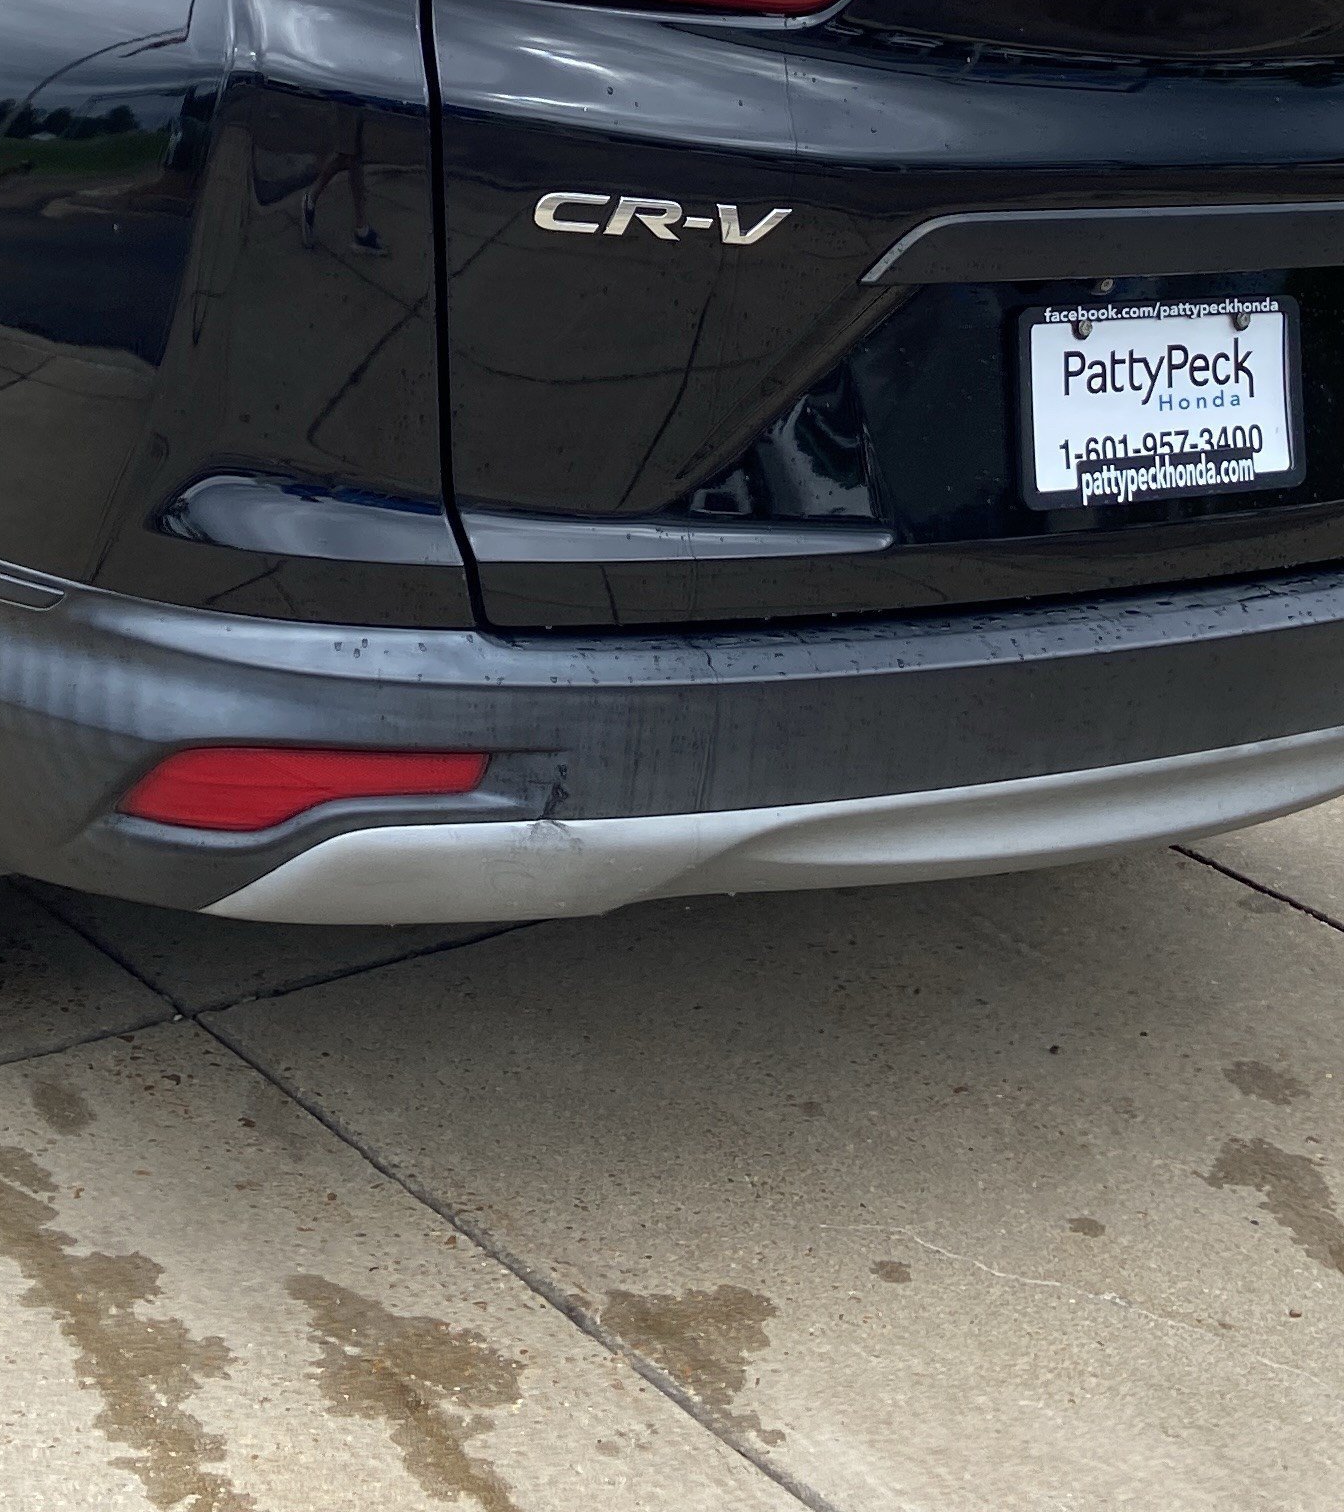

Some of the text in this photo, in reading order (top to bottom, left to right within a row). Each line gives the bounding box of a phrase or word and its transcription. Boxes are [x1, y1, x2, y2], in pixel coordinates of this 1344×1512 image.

[533, 191, 793, 245] CR-V
[1044, 297, 1279, 322] facebook.com/pattypeckhonda
[1062, 337, 1256, 406] PattyPeck
[1158, 390, 1241, 412] Honda
[1058, 424, 1263, 470] 1-601-957-3400
[1081, 455, 1255, 506] pattypeckhonda.com
